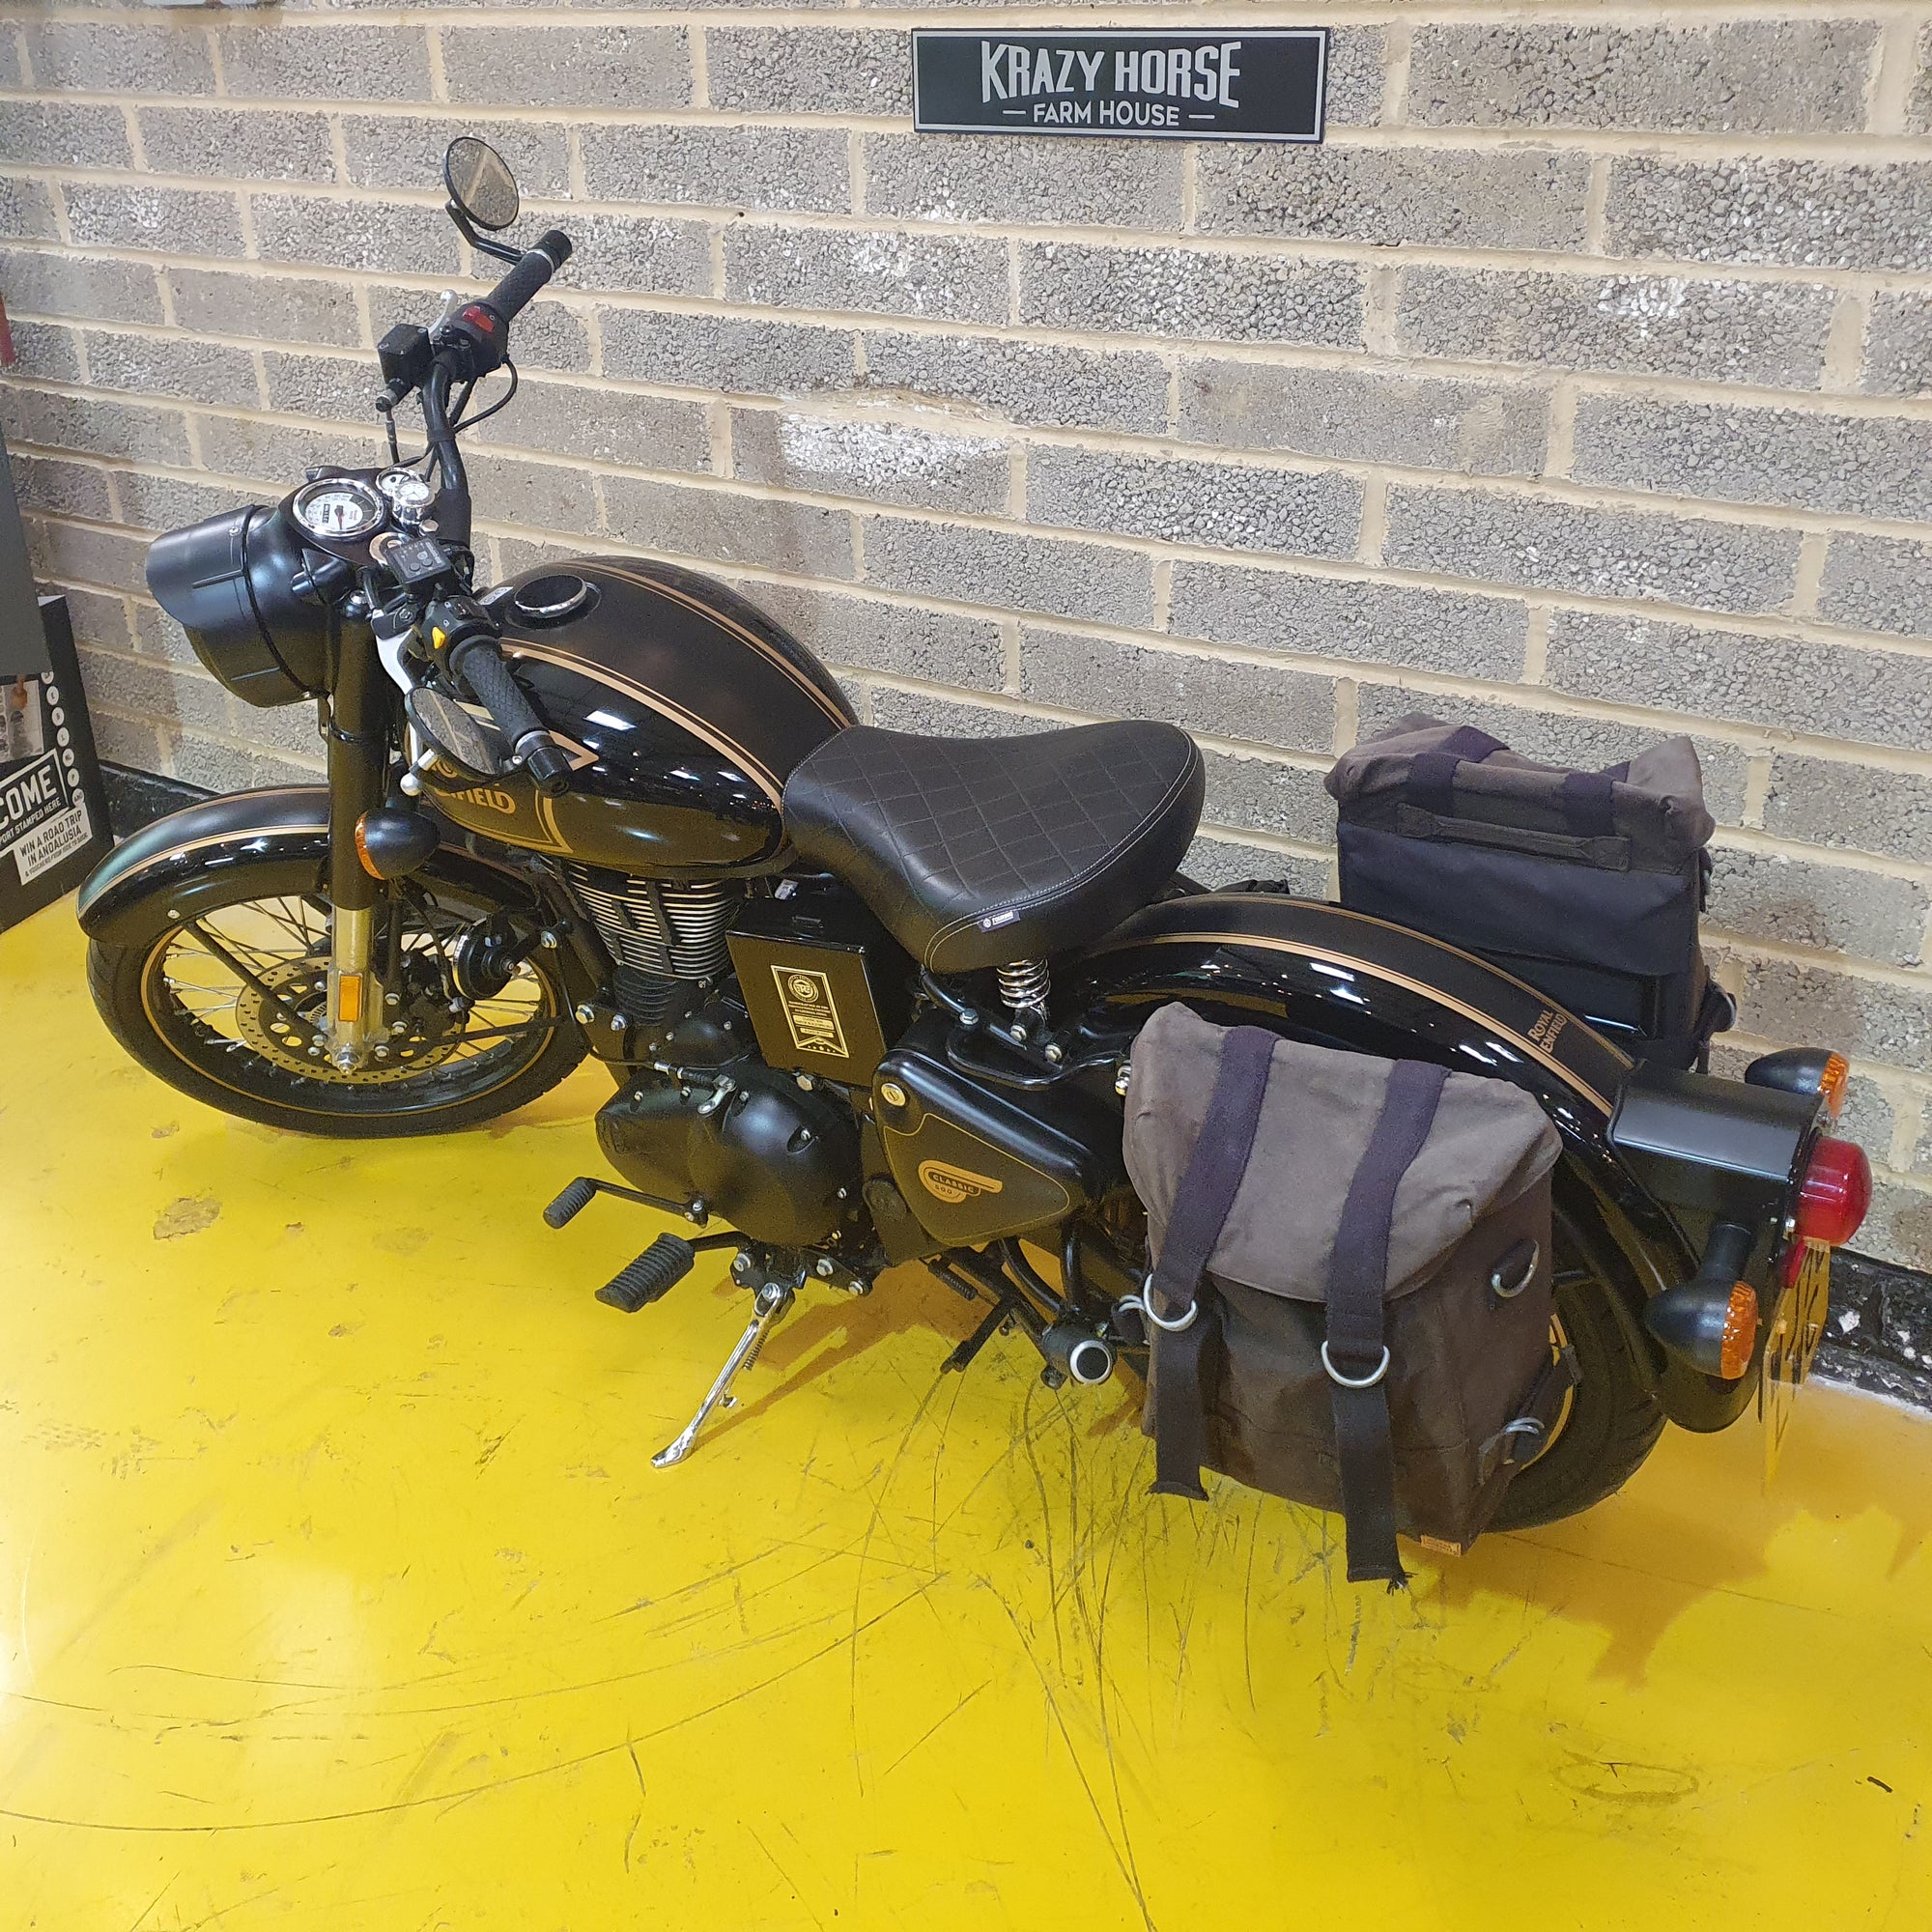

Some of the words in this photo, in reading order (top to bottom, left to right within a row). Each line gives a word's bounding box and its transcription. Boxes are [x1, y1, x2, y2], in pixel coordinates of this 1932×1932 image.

[981, 40, 1104, 103] KRAZY
[1115, 41, 1242, 109] HORSE
[1033, 100, 1091, 124] FARM
[1099, 100, 1179, 127] HOUSE
[15, 809, 44, 835] STAMPED
[43, 797, 61, 814] HERE
[434, 787, 516, 814] FIELD
[19, 840, 36, 858] WIN
[37, 836, 43, 846] A
[43, 821, 65, 843] ROAD
[65, 810, 82, 828] TRIP
[27, 852, 37, 867] IN
[39, 825, 82, 858] ANDALUSIA
[1527, 1009, 1553, 1041] ROYAL
[1540, 1013, 1568, 1053] ENFIELD
[932, 1174, 975, 1193] CLASSIC
